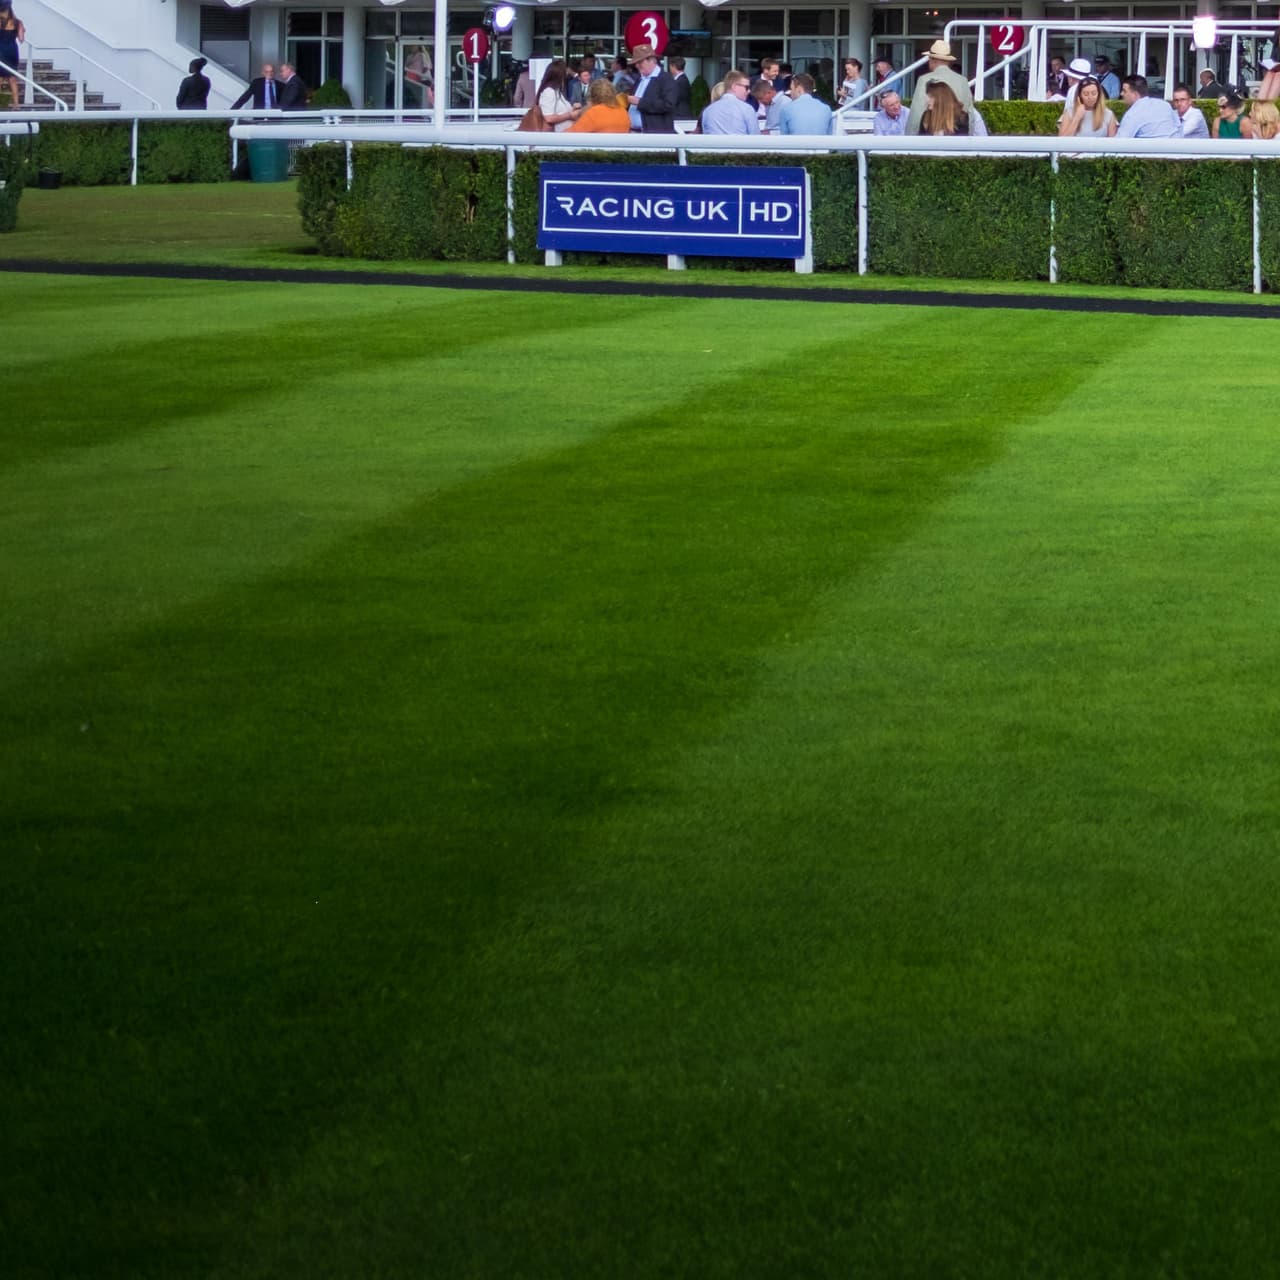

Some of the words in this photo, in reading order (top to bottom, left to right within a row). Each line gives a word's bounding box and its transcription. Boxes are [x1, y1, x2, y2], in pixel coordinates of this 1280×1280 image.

[469, 32, 480, 59] 1
[641, 17, 658, 51] 3
[998, 23, 1014, 51] 2
[555, 196, 675, 220] RACING
[686, 199, 729, 221] UK
[749, 201, 793, 223] HD
